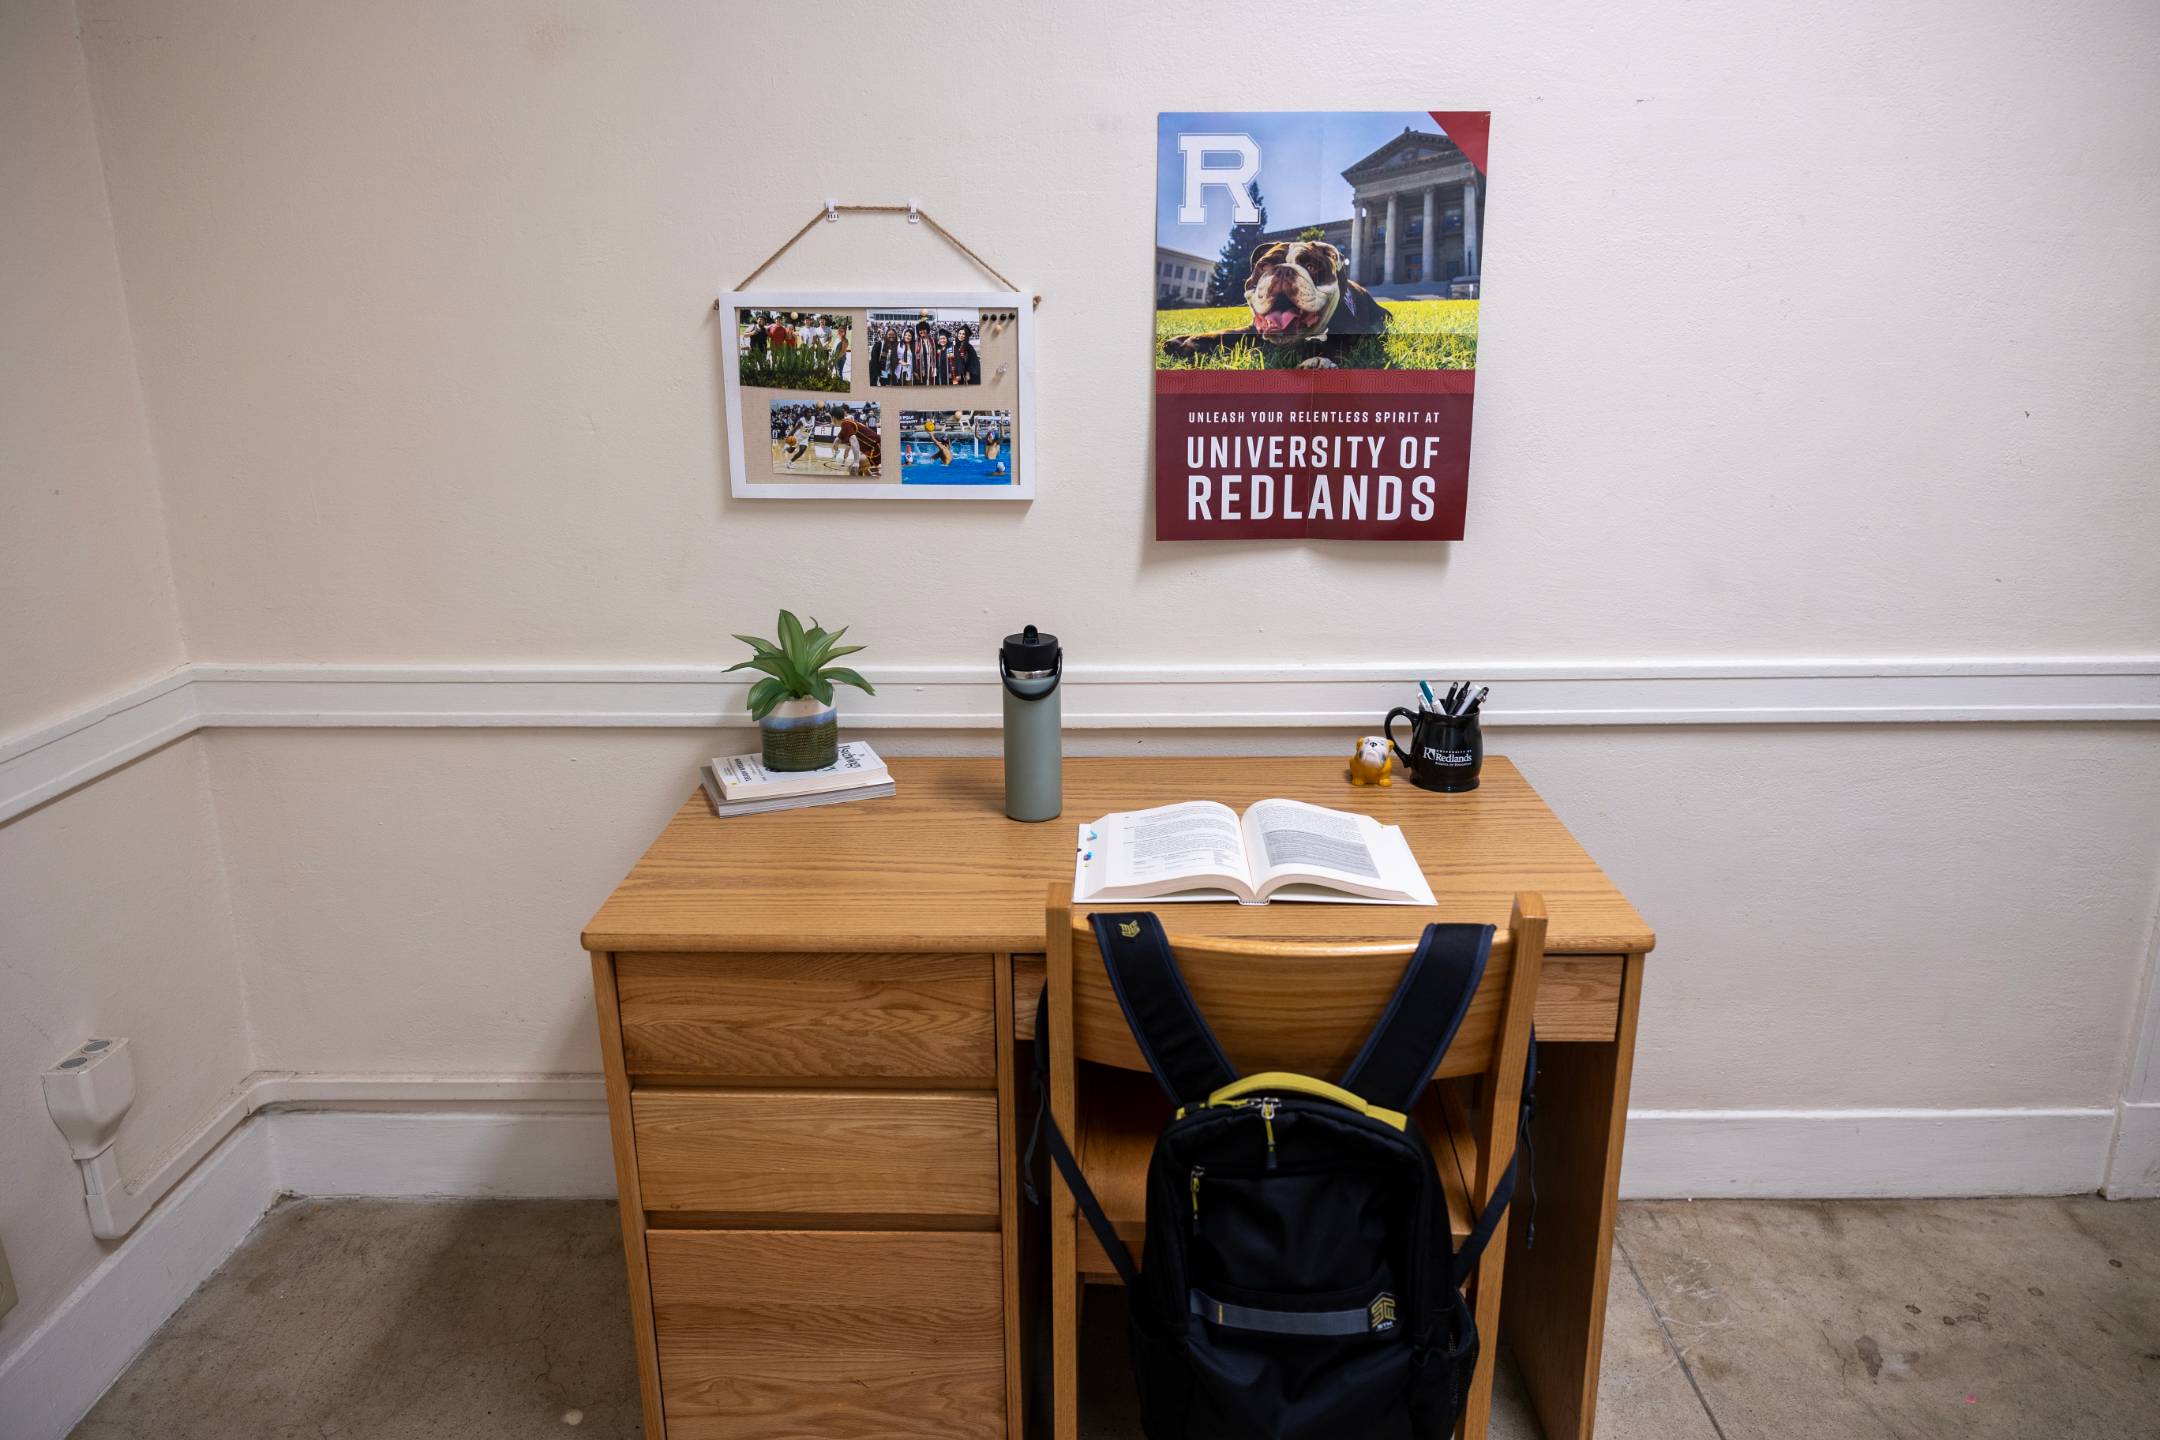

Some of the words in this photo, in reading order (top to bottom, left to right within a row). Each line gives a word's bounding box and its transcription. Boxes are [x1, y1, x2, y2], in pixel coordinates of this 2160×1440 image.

[1178, 132, 1262, 225] R
[1188, 411, 1245, 423] UNLEASH
[1251, 411, 1283, 423] YOUR
[1290, 411, 1369, 423] RELENTLESS
[1375, 411, 1420, 423] SPIRIT
[1425, 411, 1440, 423] AT
[1187, 436, 1386, 469] UNIVERSITY
[1399, 436, 1440, 469] OF
[1188, 474, 1436, 522] REDLANDS
[1435, 753, 1473, 763] Redlands
